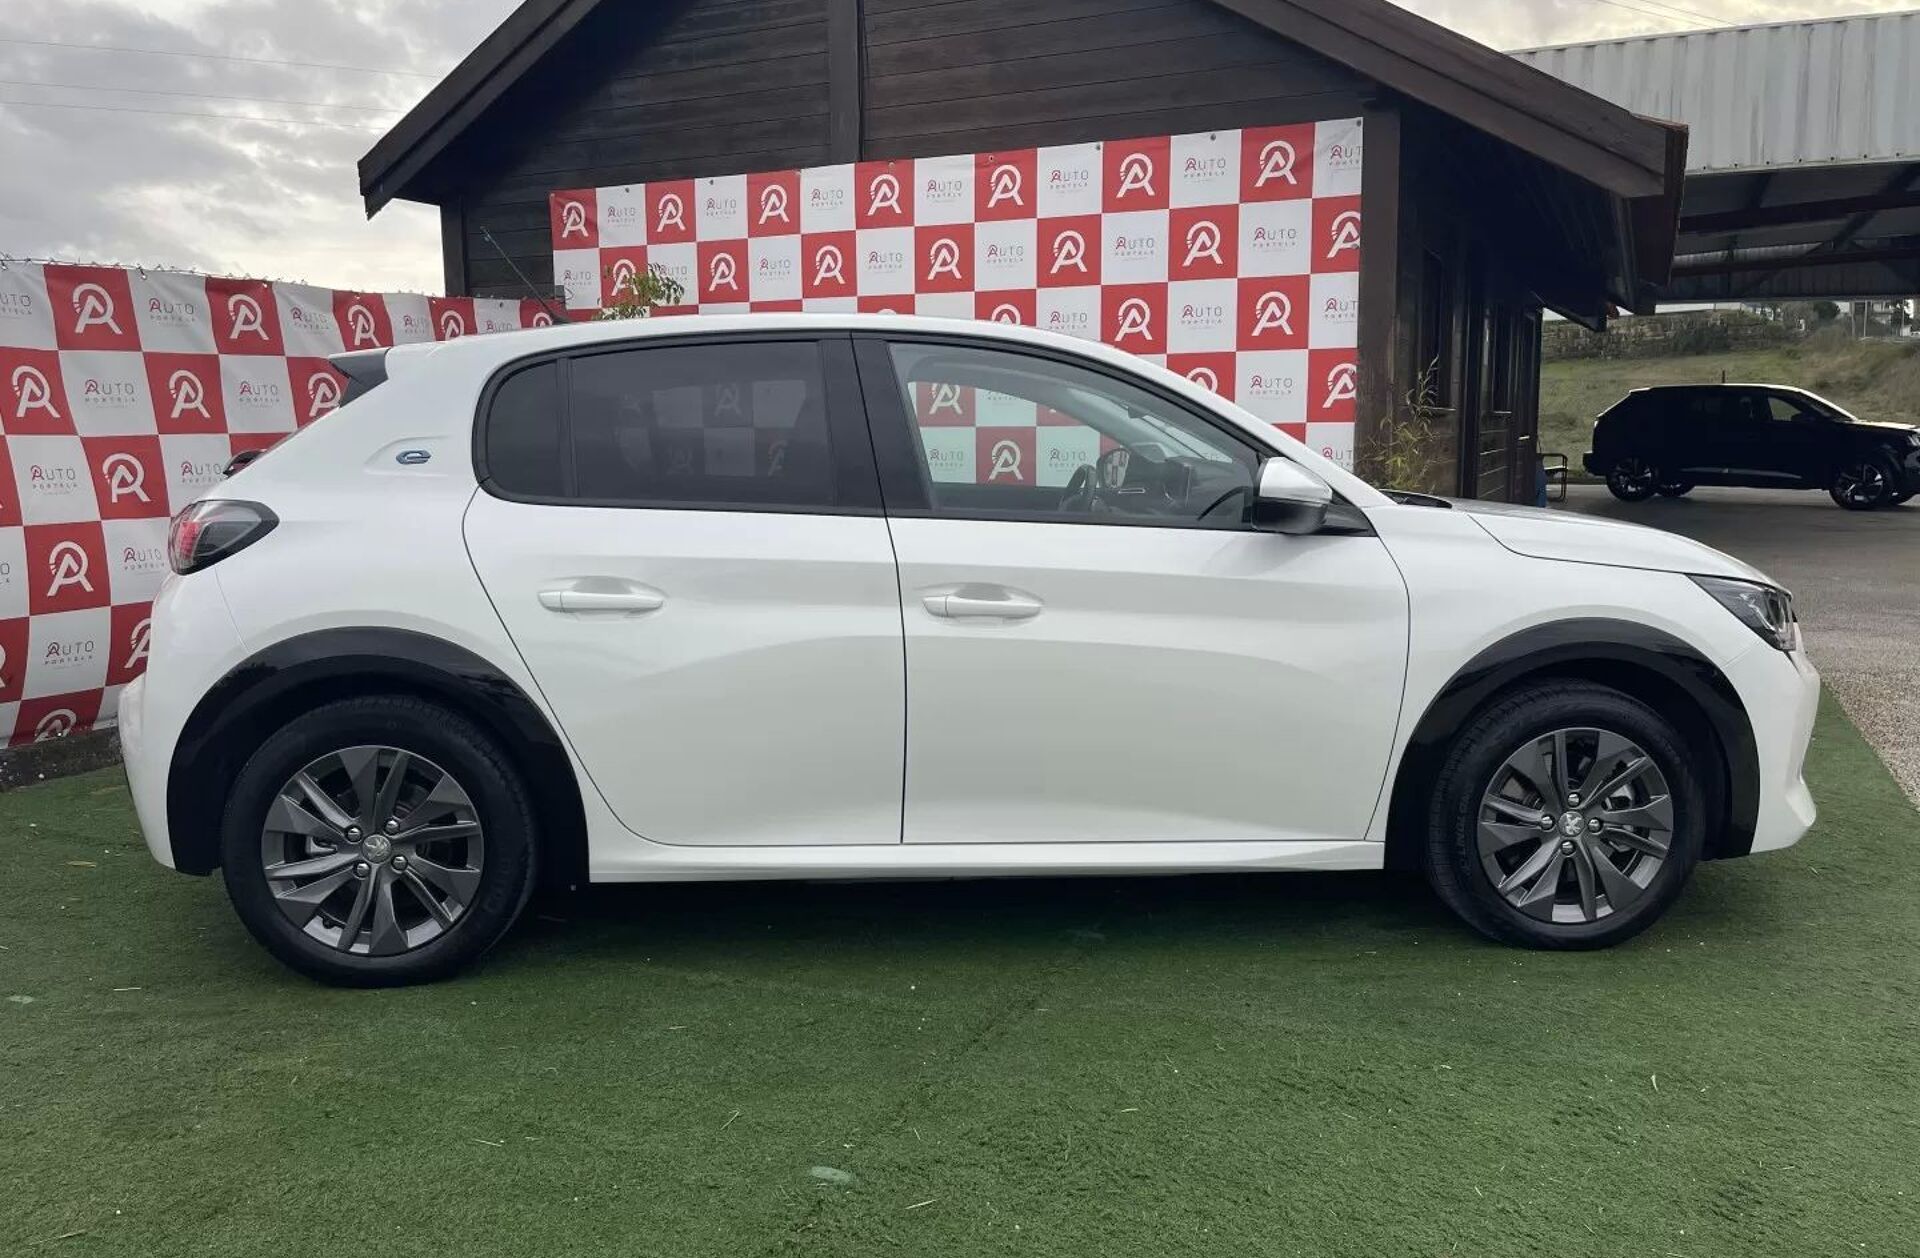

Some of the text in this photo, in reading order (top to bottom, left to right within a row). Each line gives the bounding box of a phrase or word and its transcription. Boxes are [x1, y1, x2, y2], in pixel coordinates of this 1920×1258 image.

[1330, 144, 1361, 159] AUT
[1185, 158, 1226, 170] AUTO
[1051, 170, 1089, 183] AUTO
[927, 179, 962, 192] AUTO
[812, 188, 844, 201] AUTO
[706, 197, 737, 210] AUTO
[608, 206, 635, 217] AUTO
[1254, 227, 1296, 241] AUTO
[1116, 236, 1154, 250] AUTO
[987, 244, 1024, 257] AUTO
[760, 258, 791, 270] AUTO
[869, 251, 903, 264] AUTO
[0, 294, 31, 307] UTO
[149, 298, 194, 314] AUTO
[1325, 297, 1358, 312] AUT
[1050, 311, 1087, 324] AUTO
[1182, 304, 1222, 318] AUTO
[85, 379, 134, 395] AUTO
[1250, 375, 1293, 388] AUTO
[240, 381, 278, 396] AUTO
[1323, 447, 1353, 460] AUT
[30, 465, 76, 481] AUTO
[181, 461, 222, 476] AUTO
[124, 547, 162, 563] AUTO
[46, 640, 94, 657] AUTO
